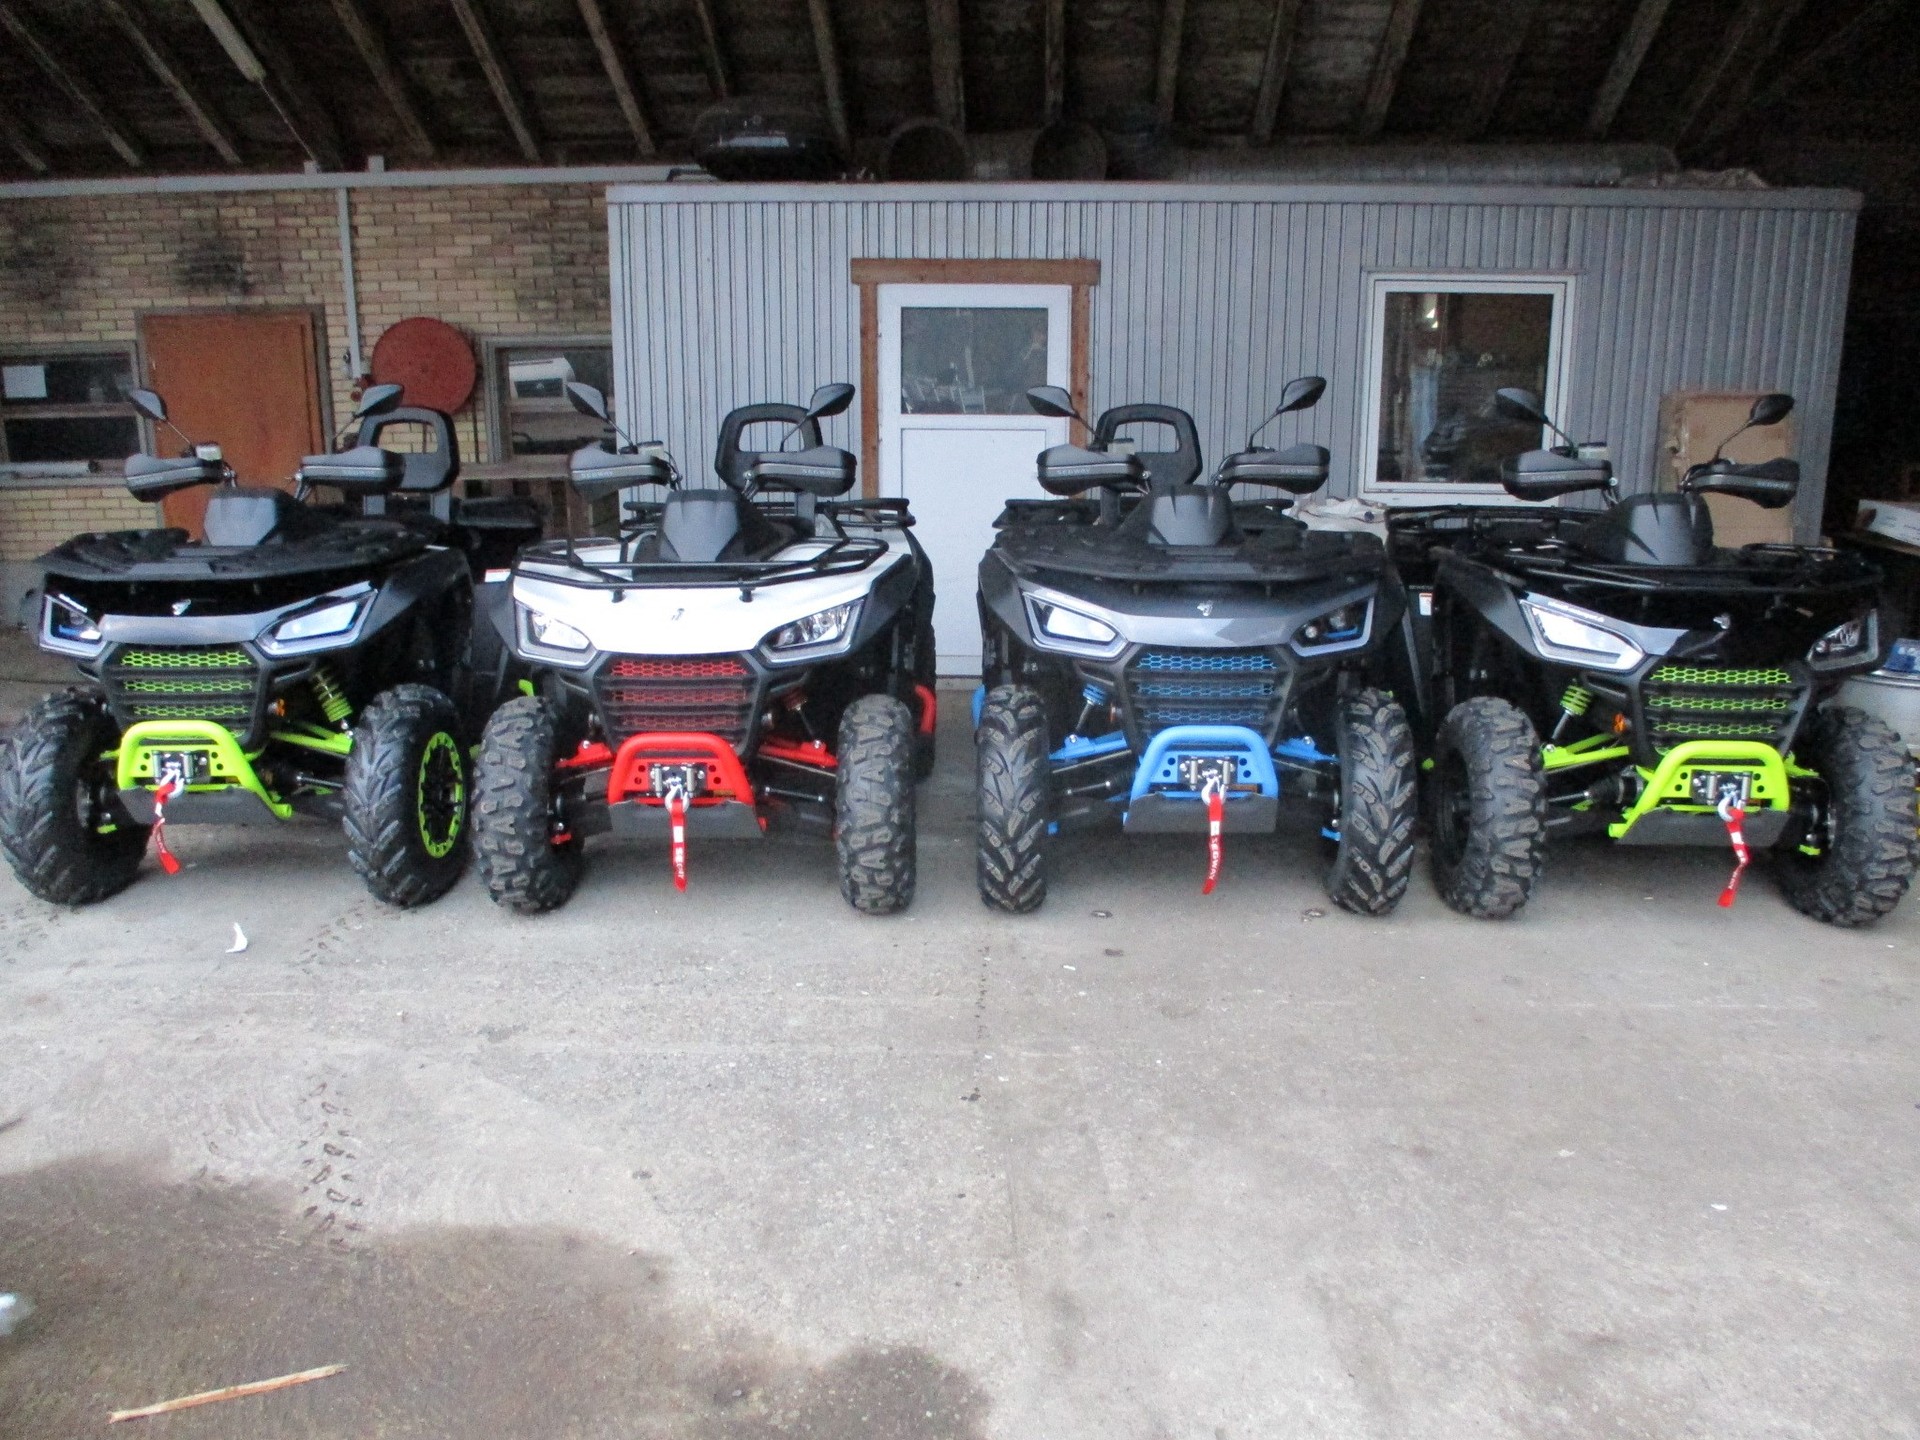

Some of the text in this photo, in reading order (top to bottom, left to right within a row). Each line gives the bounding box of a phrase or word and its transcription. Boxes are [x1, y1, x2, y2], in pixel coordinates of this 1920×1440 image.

[580, 471, 613, 479] SEGWAY
[1057, 467, 1090, 475] SEGWAY
[1208, 837, 1219, 880] SEGWAY
